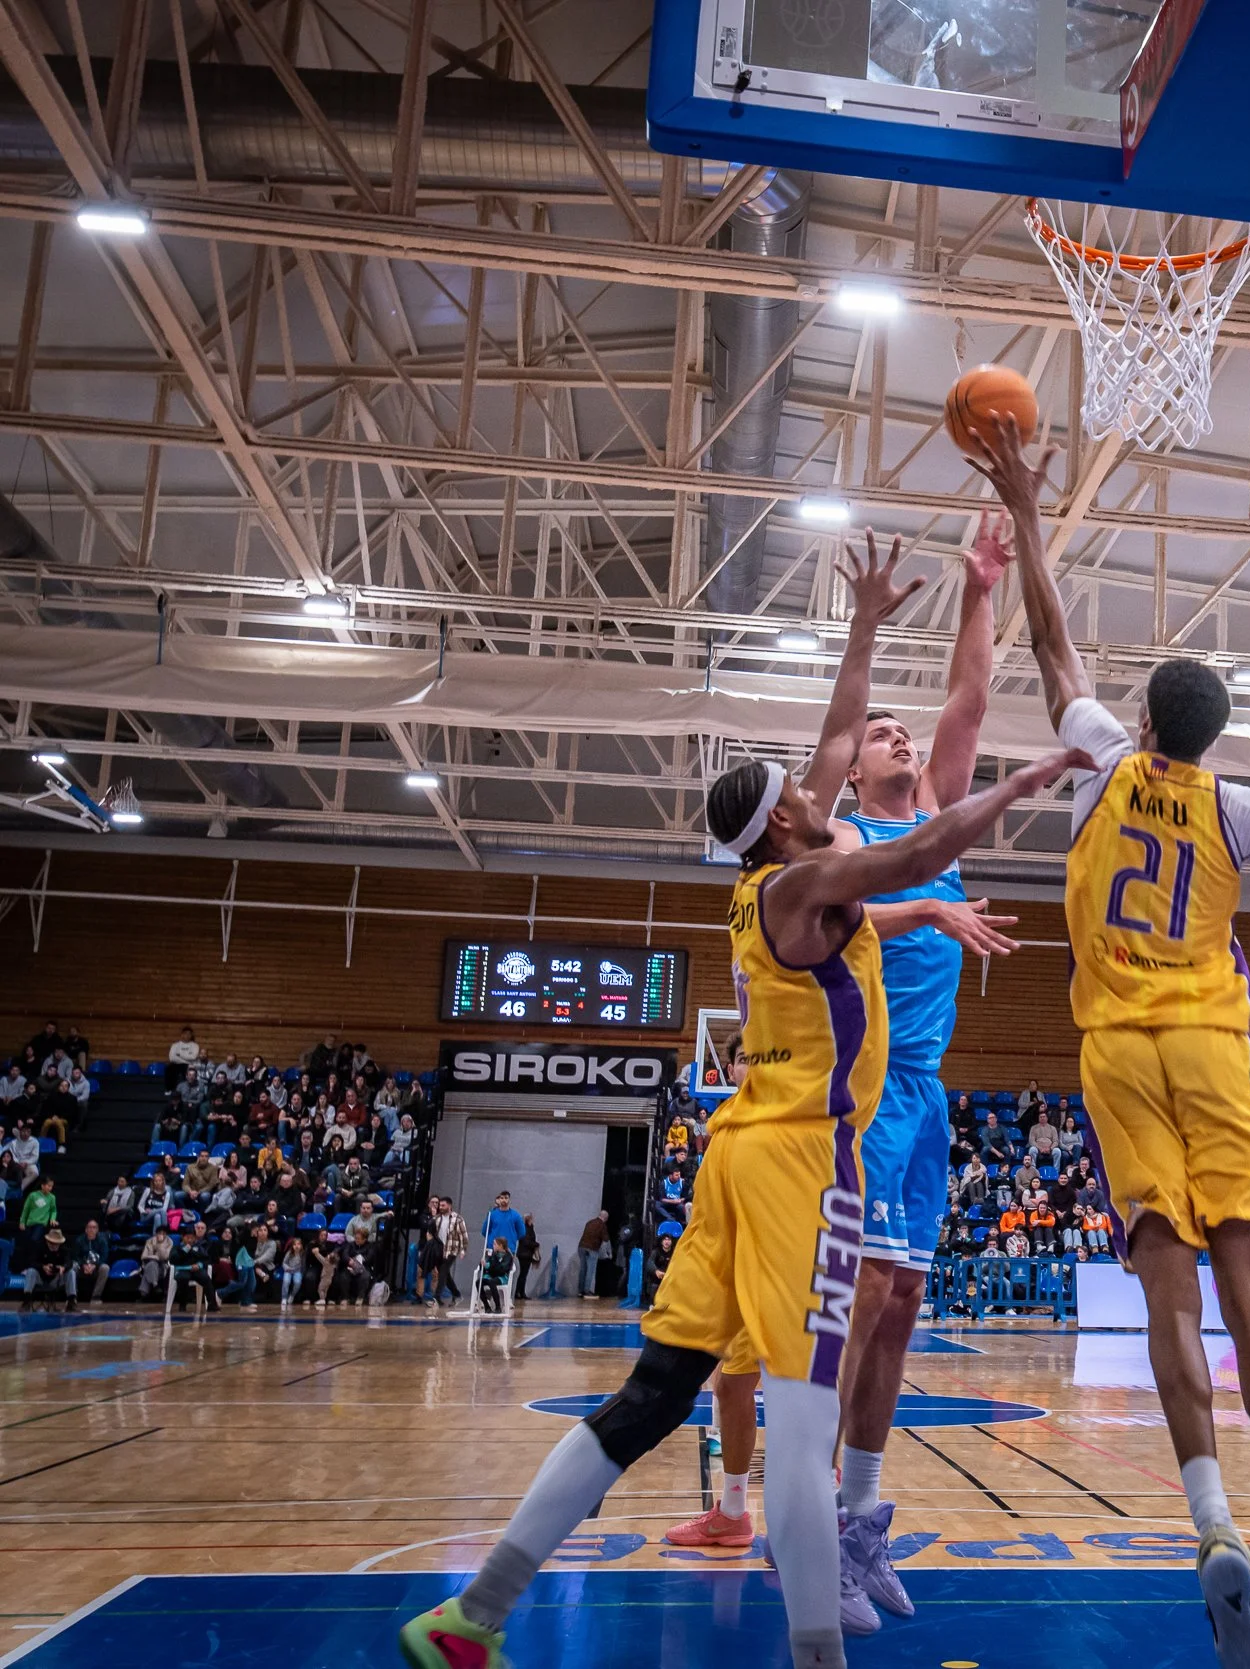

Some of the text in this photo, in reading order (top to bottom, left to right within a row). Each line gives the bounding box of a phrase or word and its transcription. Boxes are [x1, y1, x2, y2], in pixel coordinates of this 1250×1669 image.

[1105, 823, 1196, 941] 21
[550, 959, 582, 973] 5:42
[599, 972, 633, 986] UEM
[499, 1000, 526, 1017] 46
[600, 1004, 626, 1020] 45
[453, 1051, 663, 1087] SIROKO
[804, 1185, 864, 1343] UEM
